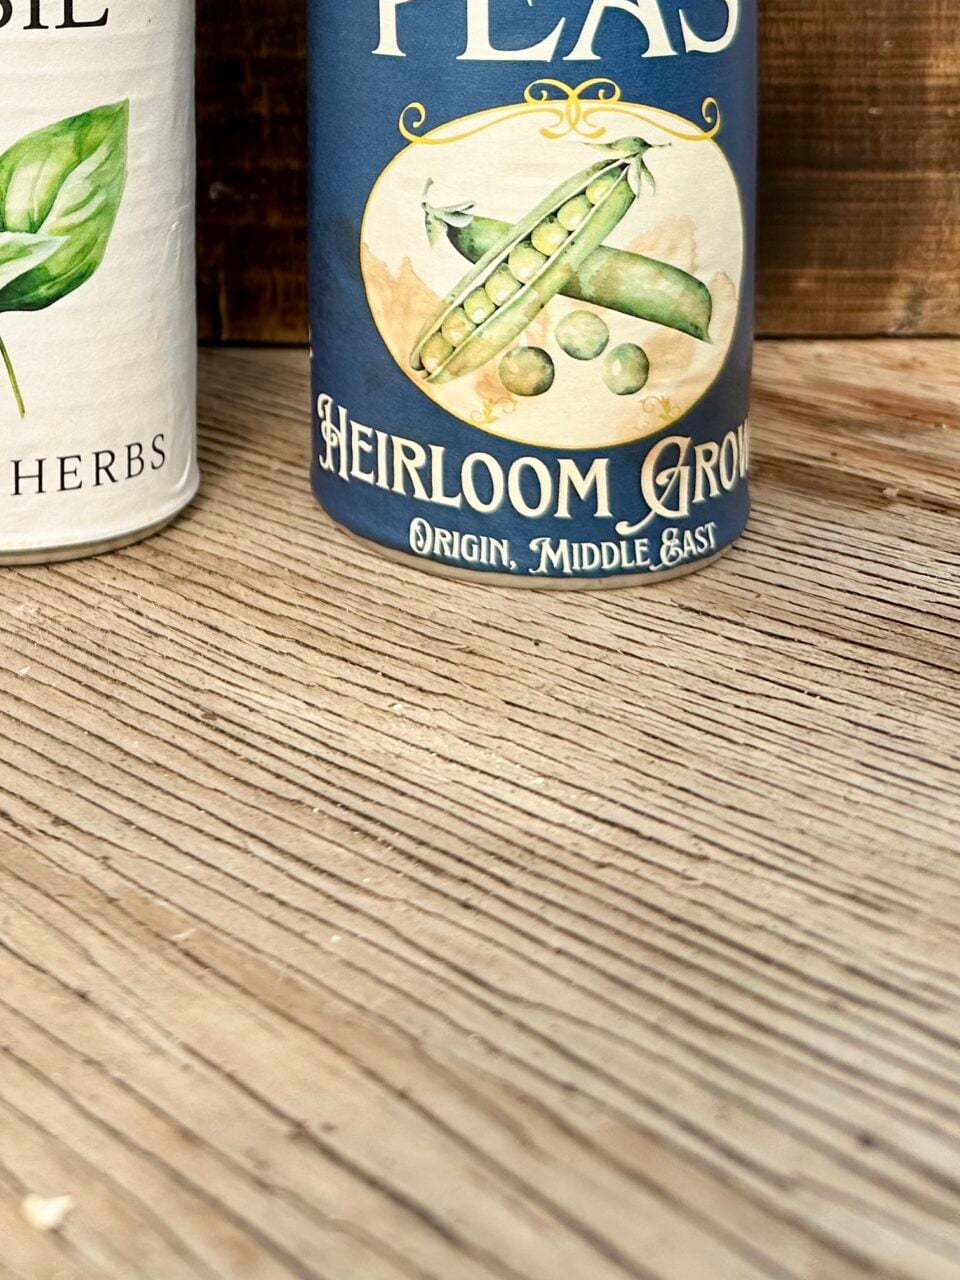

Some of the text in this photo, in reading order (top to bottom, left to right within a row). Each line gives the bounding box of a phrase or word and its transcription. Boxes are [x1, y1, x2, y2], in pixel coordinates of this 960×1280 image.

[10, 433, 167, 496] HERBS
[317, 393, 612, 519] HEIRLOOM
[409, 517, 717, 574] ORIGIN, MIDDLE EAST
